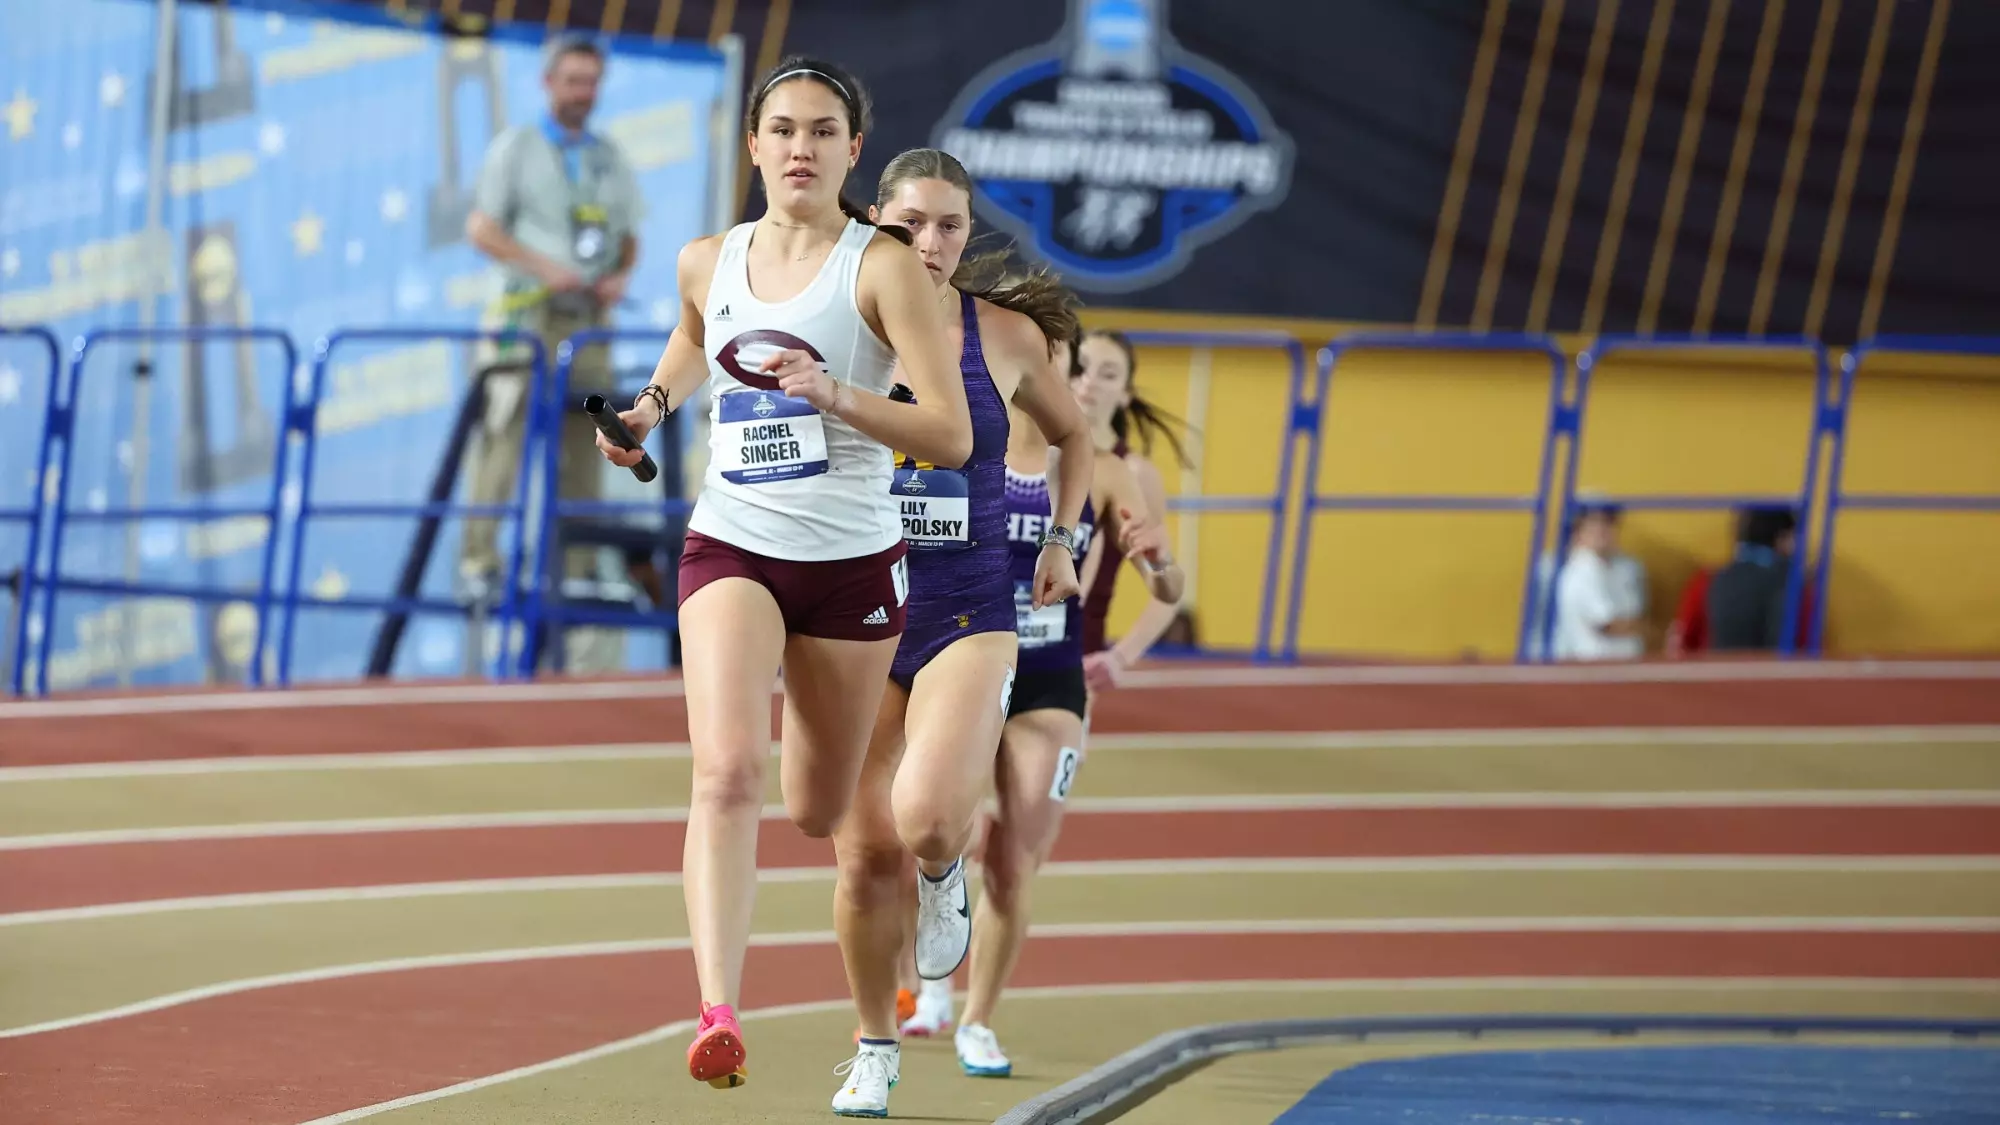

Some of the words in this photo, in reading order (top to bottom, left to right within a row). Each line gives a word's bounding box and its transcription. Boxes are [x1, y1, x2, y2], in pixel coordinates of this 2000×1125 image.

[743, 423, 794, 442] RACHEL
[741, 440, 801, 464] SINGER
[900, 501, 927, 515] LILY
